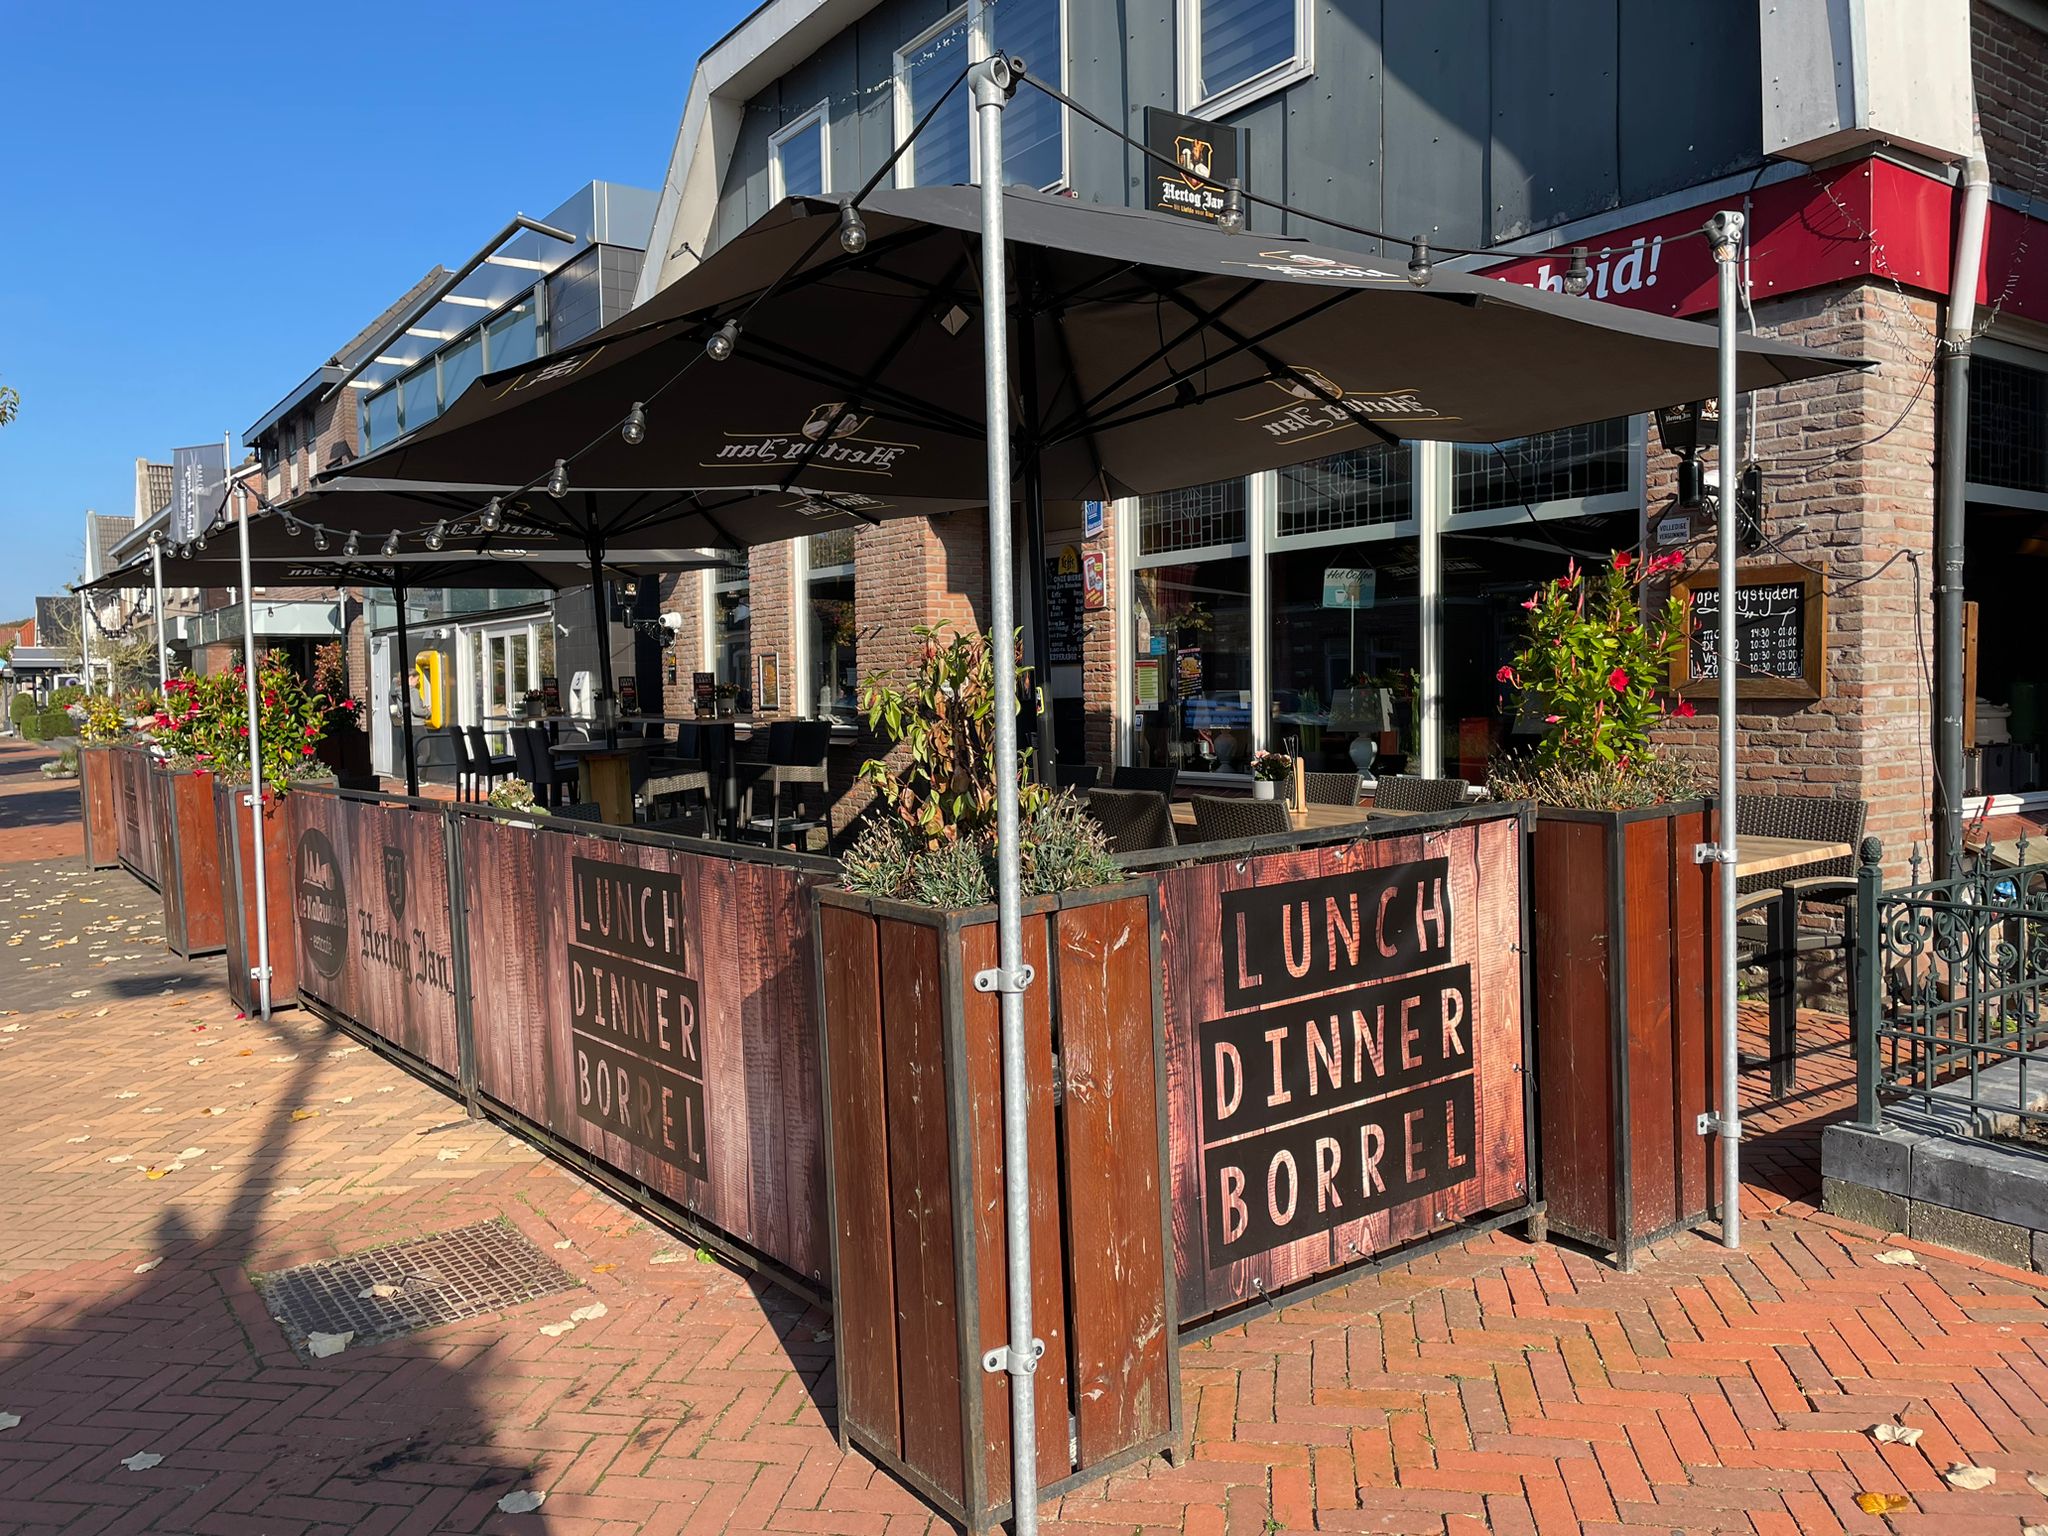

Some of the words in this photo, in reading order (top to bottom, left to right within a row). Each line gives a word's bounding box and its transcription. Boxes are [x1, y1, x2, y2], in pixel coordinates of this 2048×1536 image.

[1162, 182, 1202, 208] Hertog
[1327, 570, 1344, 579] Hot
[1345, 570, 1373, 583] Coffee
[1749, 651, 1770, 662] 10:30
[1750, 639, 1770, 650] 10:30
[358, 908, 413, 985] Hertog
[413, 928, 450, 997] Jan
[577, 872, 681, 956] LUNCH
[1235, 876, 1446, 990] LUNCH
[572, 960, 697, 1063] DINNER
[1214, 987, 1466, 1121] DINNER
[577, 1049, 700, 1164] BORREL
[1219, 1098, 1467, 1246] BORREL
